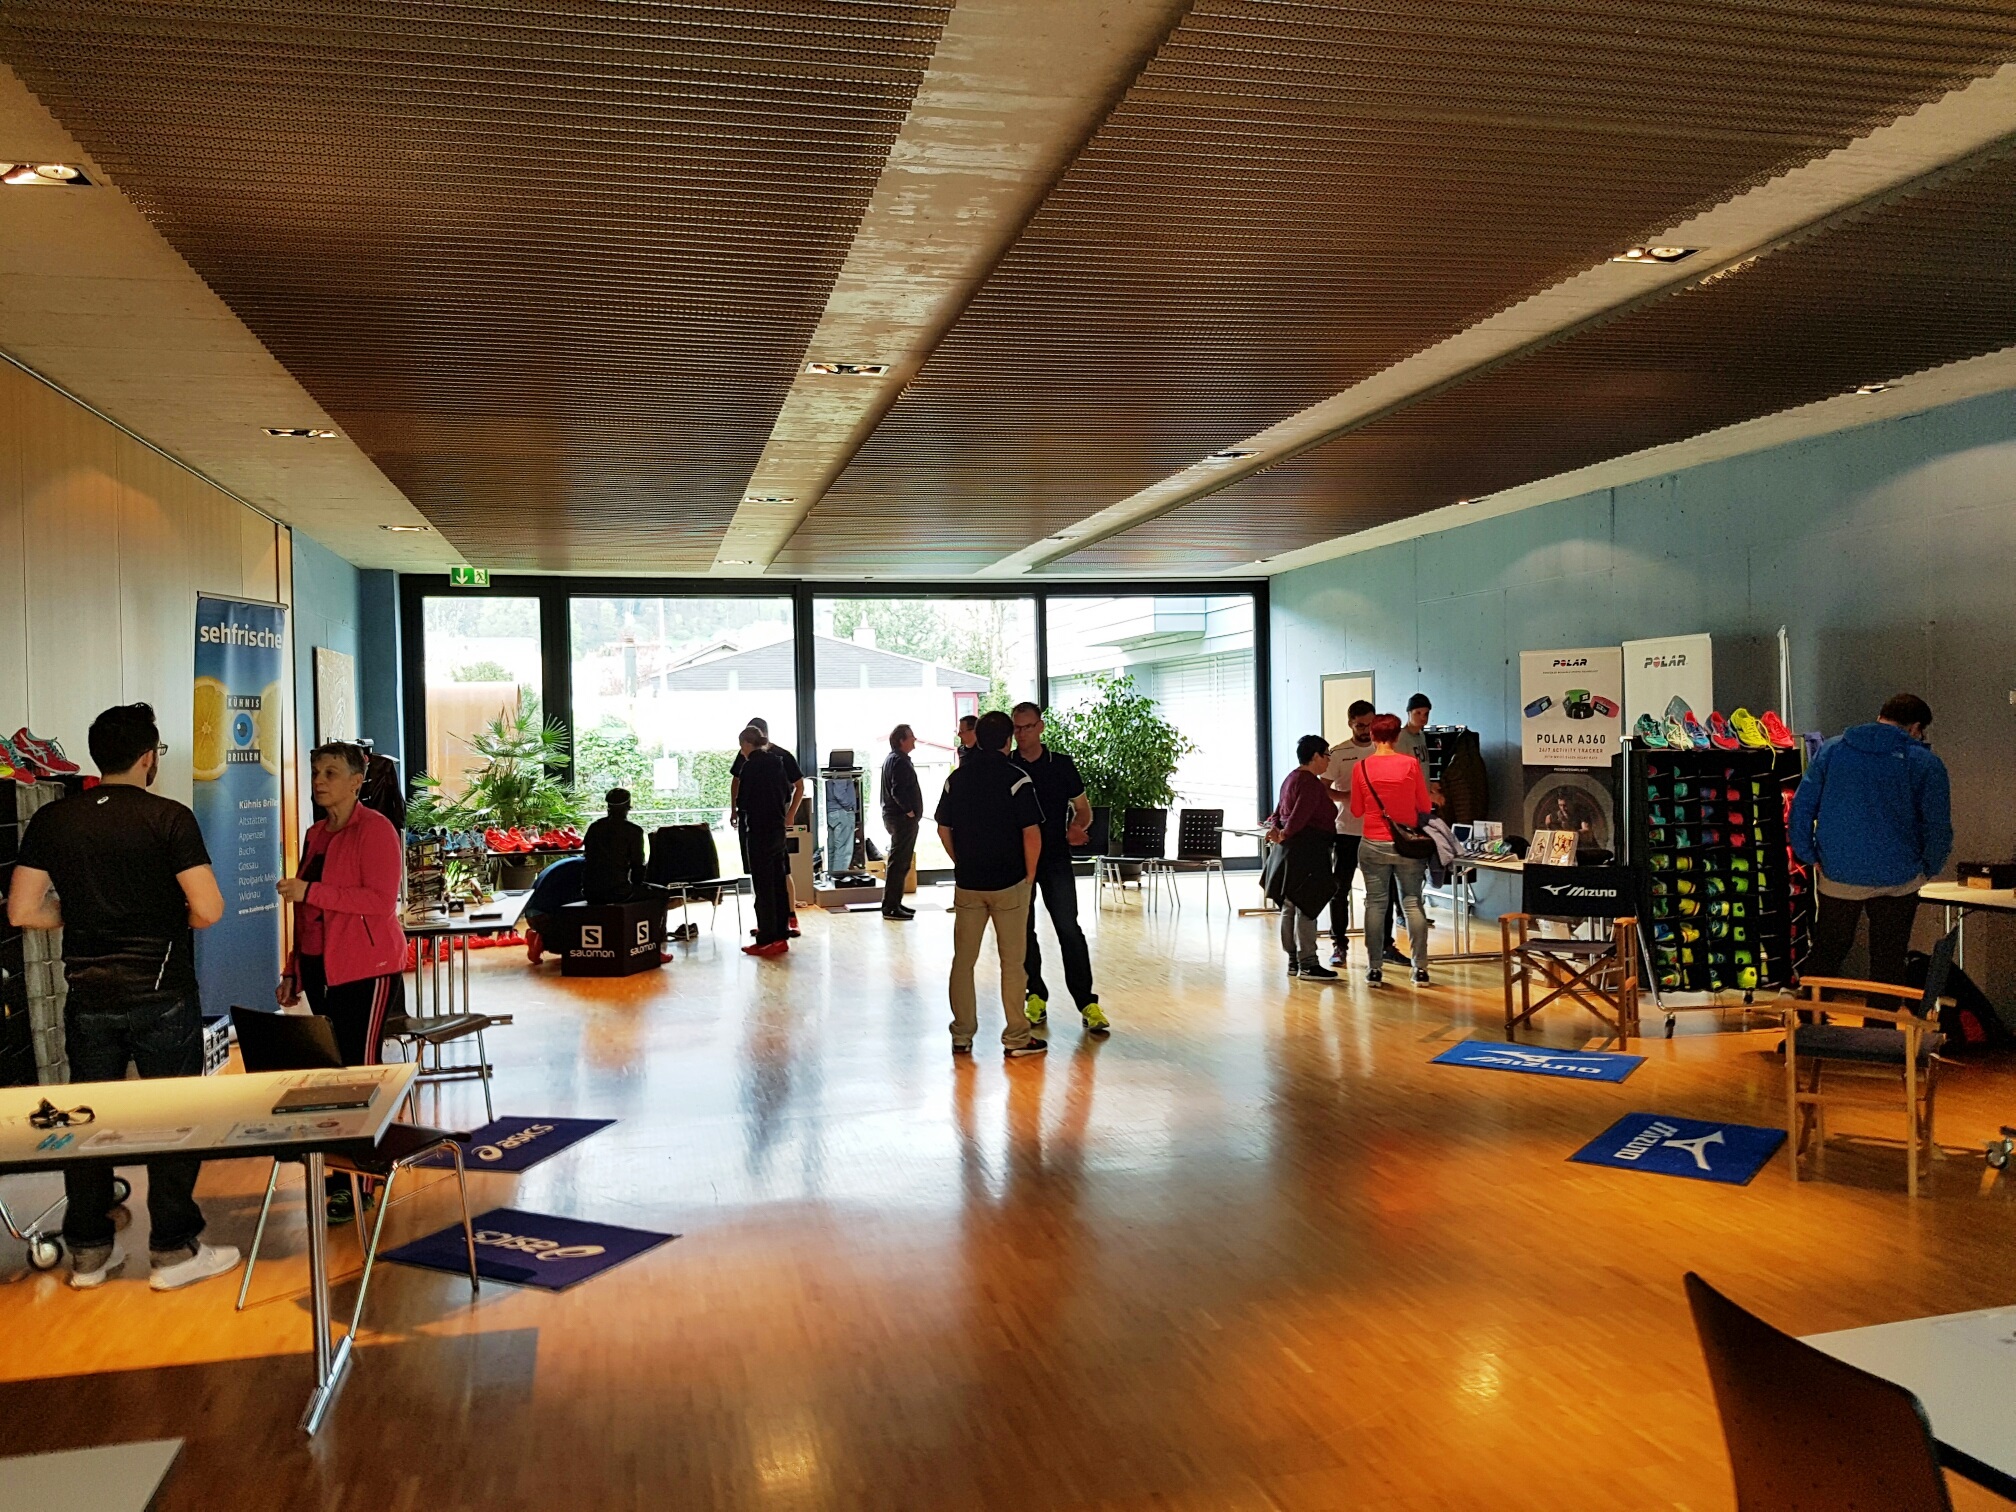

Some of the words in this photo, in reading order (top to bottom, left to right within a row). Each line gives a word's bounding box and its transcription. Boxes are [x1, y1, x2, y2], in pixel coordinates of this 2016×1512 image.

[200, 622, 283, 650] sehfrische
[1553, 659, 1588, 668] POLAR
[1644, 654, 1686, 669] POLAR
[228, 696, 260, 708] KÜHNIS
[1536, 734, 1573, 744] POLAR
[1578, 734, 1606, 744] A360
[227, 752, 259, 762] BRILLEN
[239, 799, 262, 809] Kühnis
[238, 830, 266, 842] Appenzell
[238, 847, 256, 856] Buchs
[238, 862, 259, 871] Gossau
[238, 891, 261, 901] Widnau
[569, 949, 616, 958] salomon
[630, 942, 657, 957] salomon
[494, 1124, 555, 1150] asics
